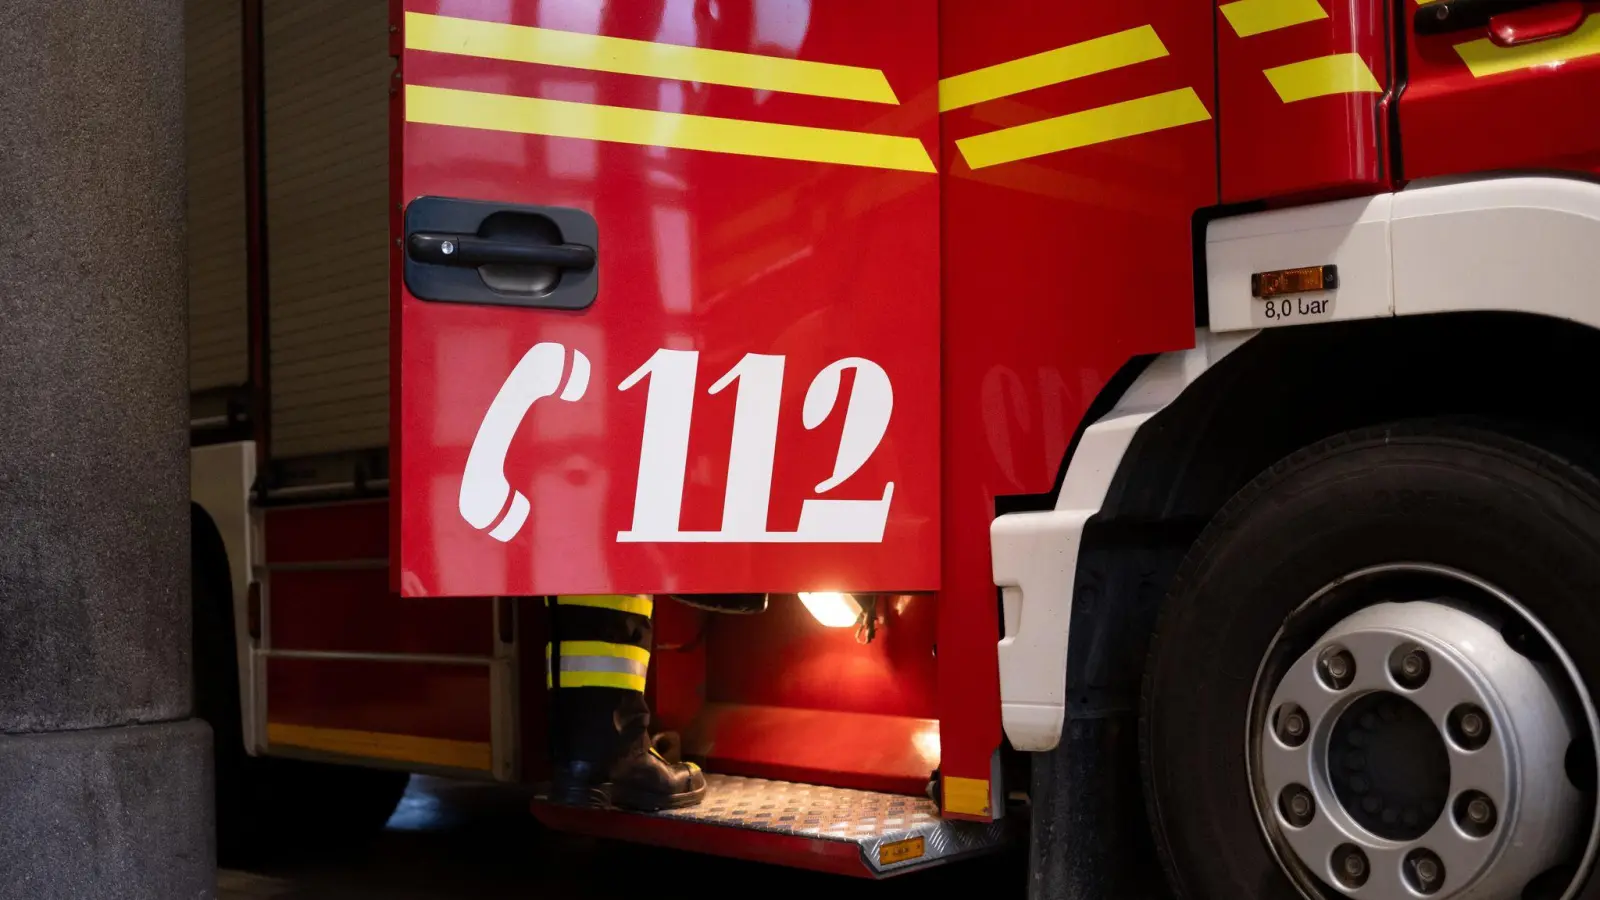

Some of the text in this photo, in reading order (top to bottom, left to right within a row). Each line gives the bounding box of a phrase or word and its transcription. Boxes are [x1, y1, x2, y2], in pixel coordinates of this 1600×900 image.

[1264, 297, 1329, 321] 8,0 bar
[616, 348, 895, 543] 112
